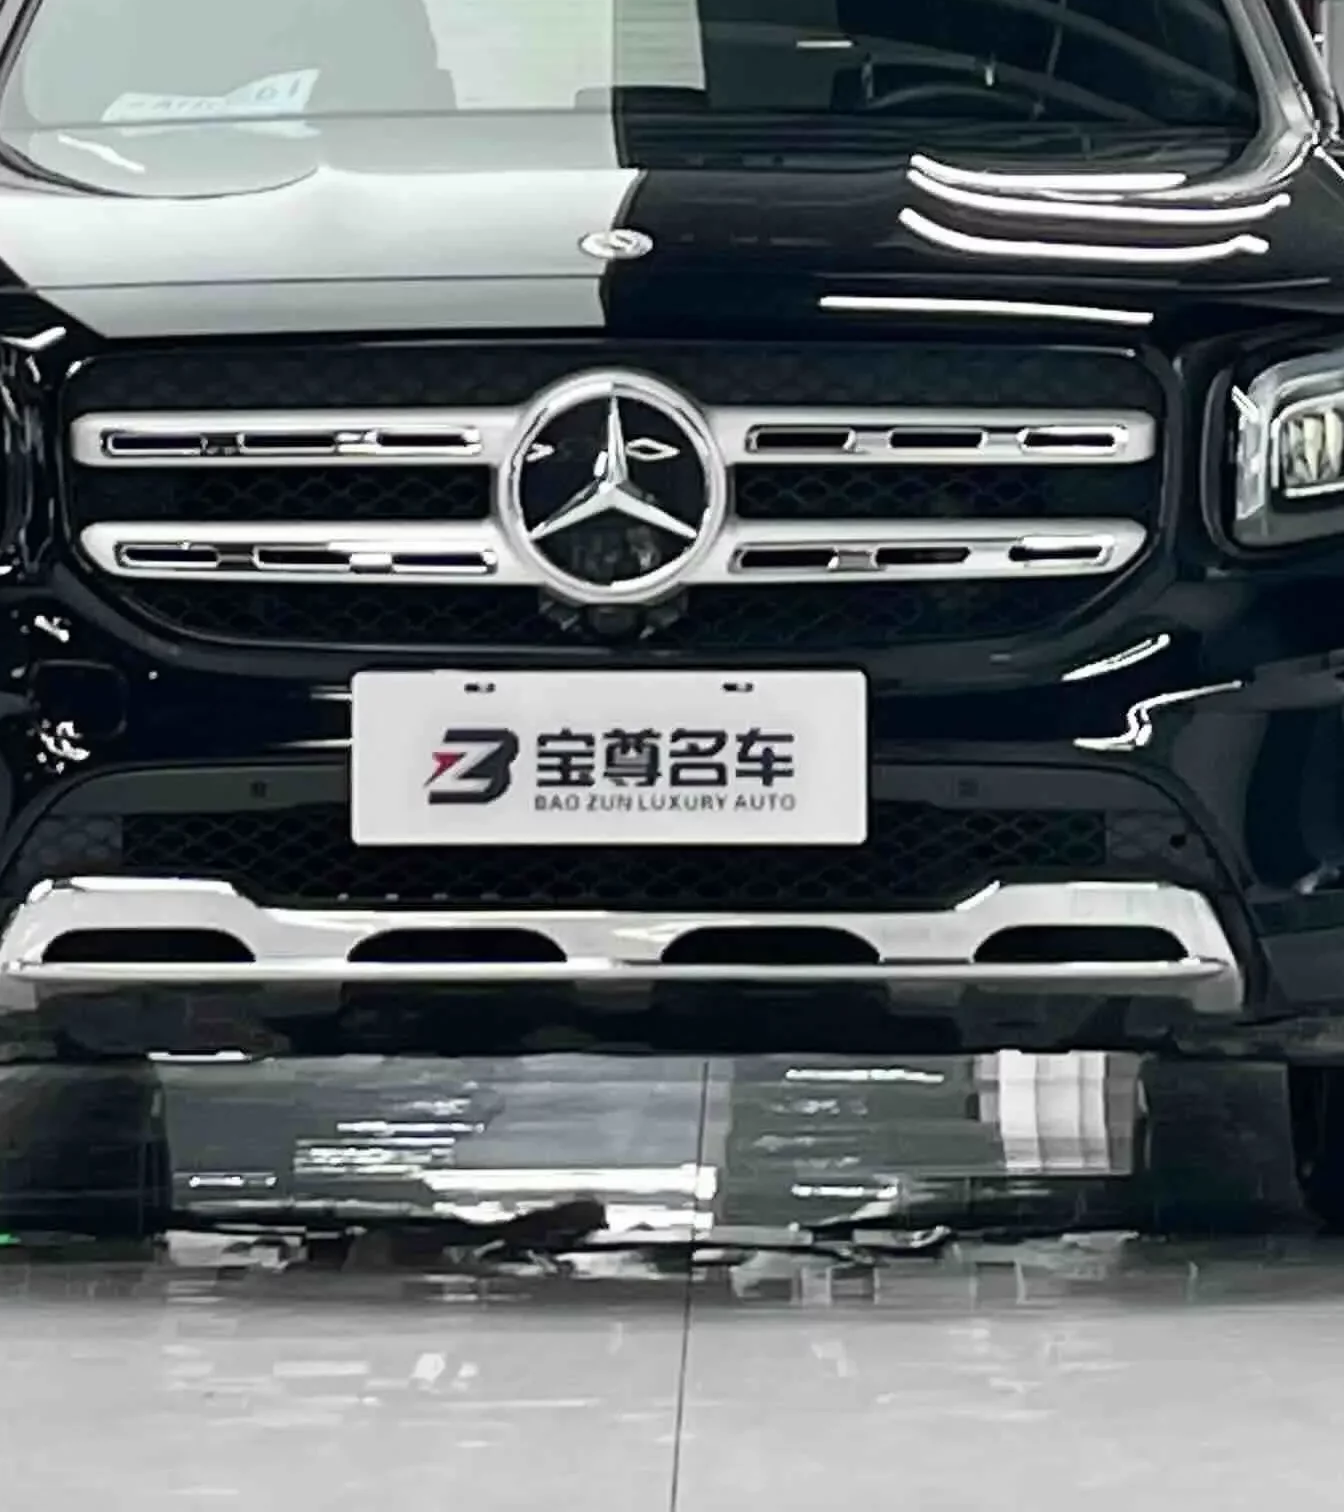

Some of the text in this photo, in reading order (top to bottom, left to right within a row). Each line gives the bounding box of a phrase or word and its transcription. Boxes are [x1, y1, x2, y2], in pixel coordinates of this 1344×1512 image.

[535, 727, 795, 788] 宝尊名车
[533, 793, 796, 812] BAO ZUN LUXURY AUTO
